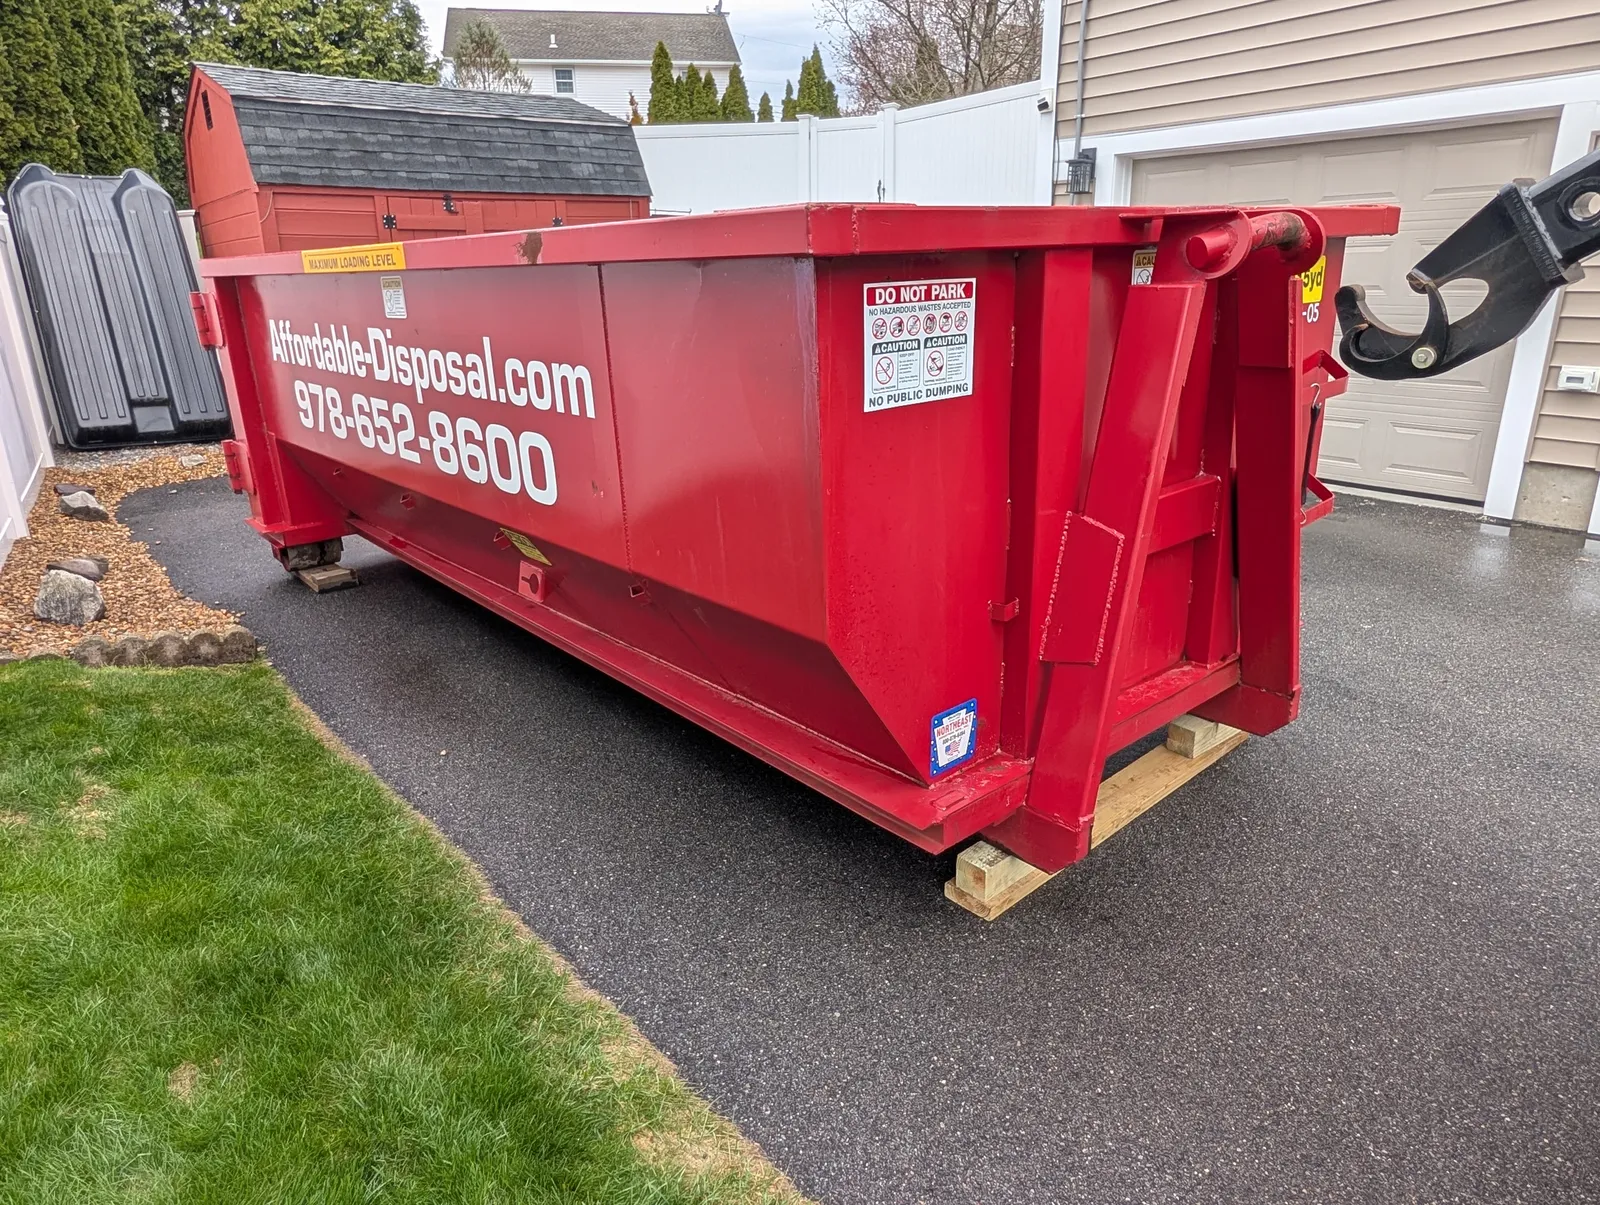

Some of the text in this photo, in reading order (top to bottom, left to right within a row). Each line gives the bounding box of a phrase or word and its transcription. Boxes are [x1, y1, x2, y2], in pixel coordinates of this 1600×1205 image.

[309, 253, 397, 270] MAXIMUM LOADING LEVEL
[875, 283, 967, 305] DO NOT PARK
[868, 301, 972, 317] NO HAZARDOUS WASTES ACCEPTED
[881, 340, 919, 354] CAUTION
[932, 335, 966, 347] CAUTION
[268, 318, 596, 420] Affordable-Disposal.com
[869, 382, 969, 408] NO PUBLIC DUMPING
[294, 379, 558, 507] 978-652-8600
[936, 713, 972, 738] NORTHEAST
